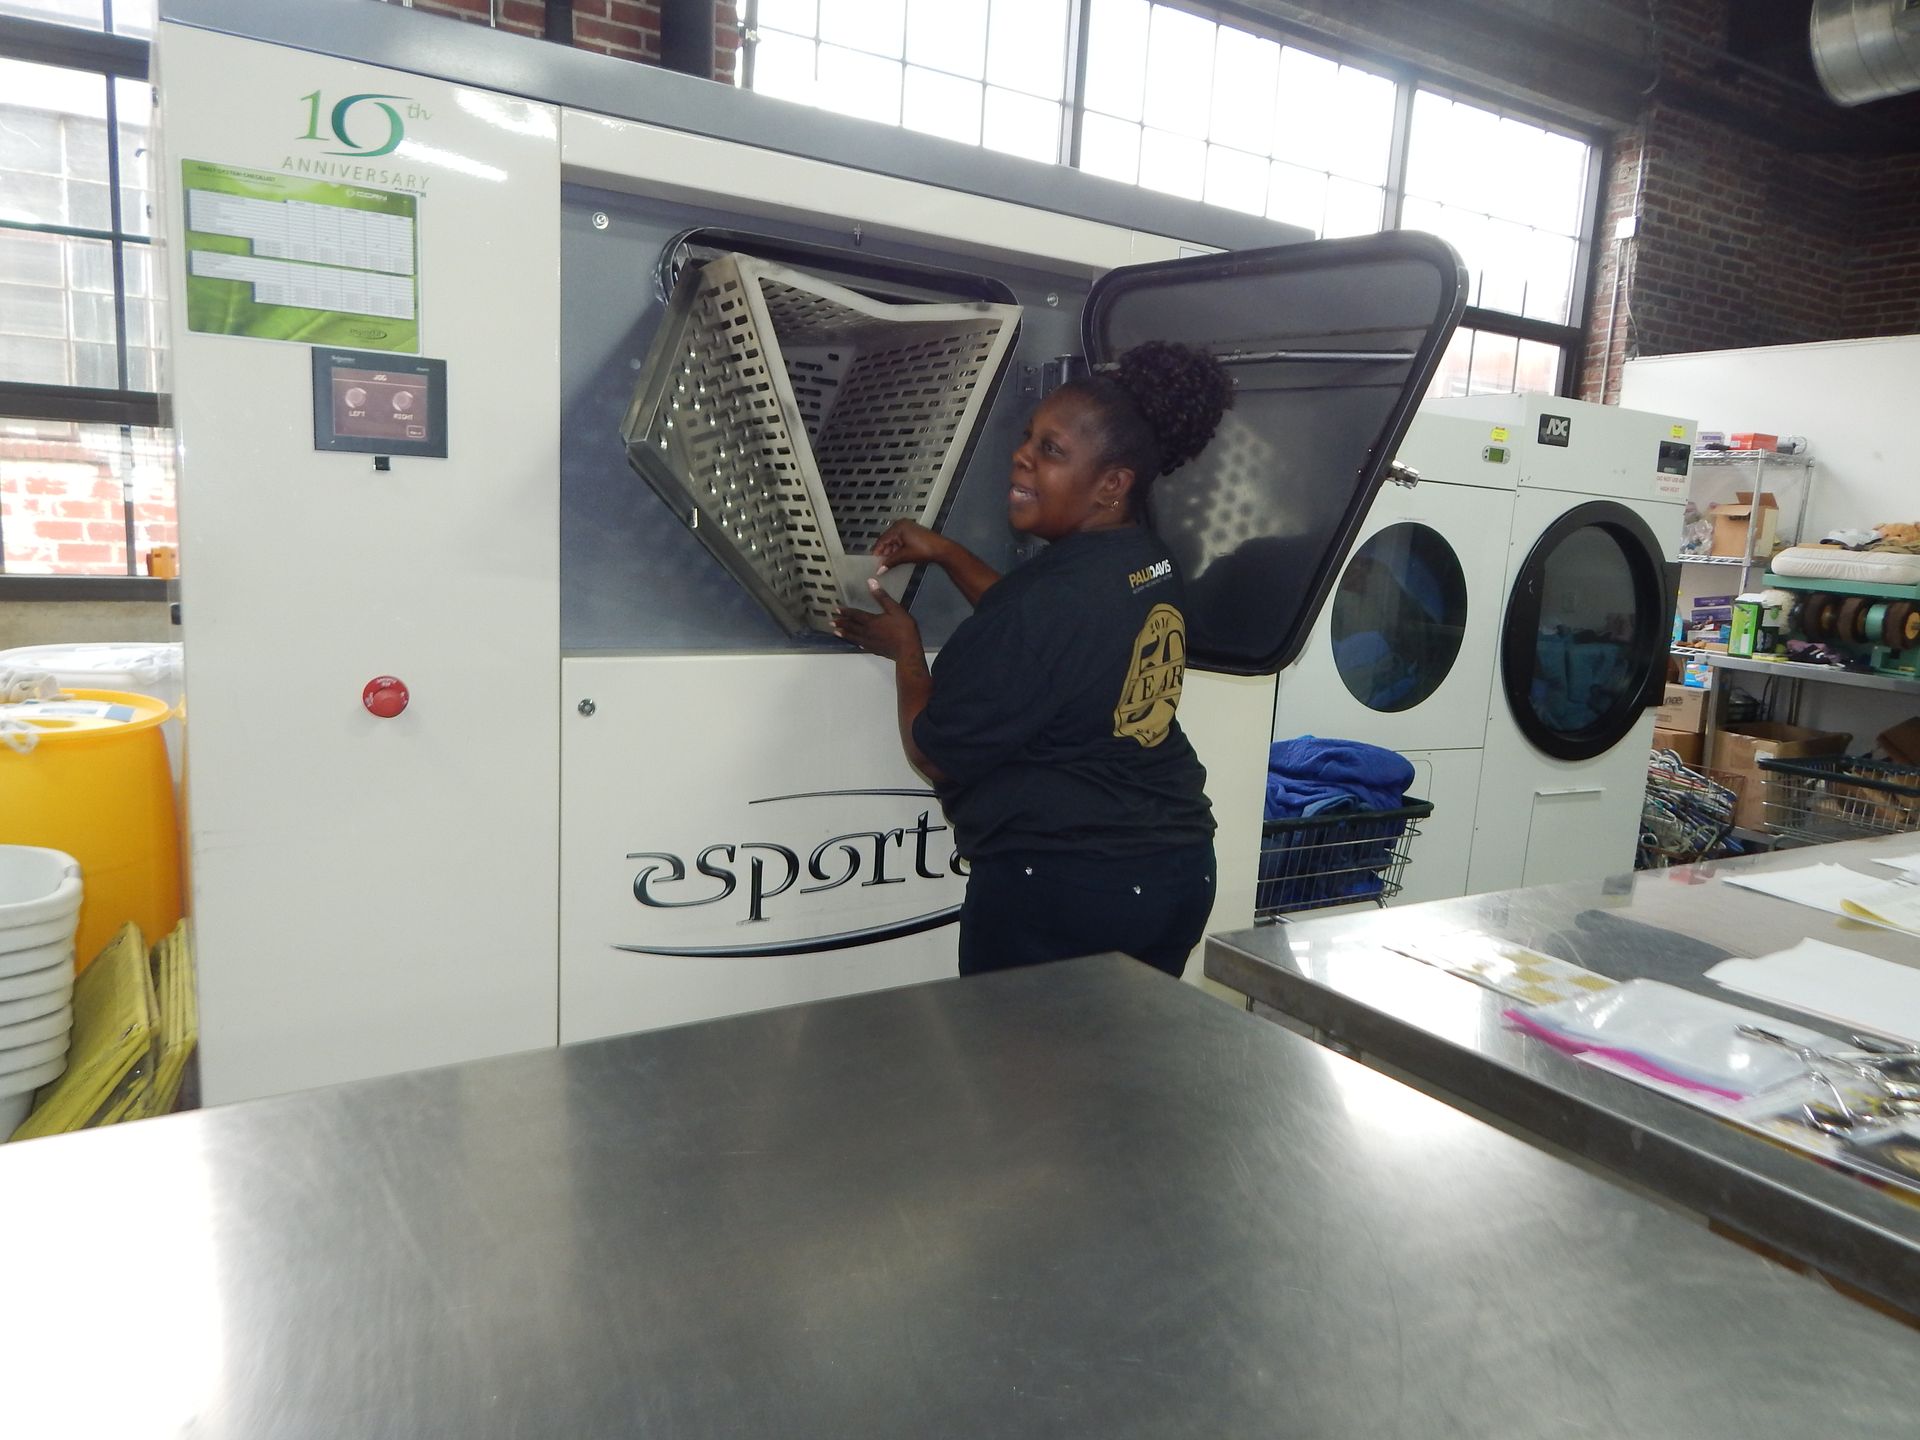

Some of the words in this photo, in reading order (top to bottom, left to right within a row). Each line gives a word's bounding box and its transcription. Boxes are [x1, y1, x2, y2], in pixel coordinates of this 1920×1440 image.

[282, 155, 431, 190] ANNIVERSARY
[393, 412, 414, 421] RIGHT
[1546, 417, 1569, 437] ADC
